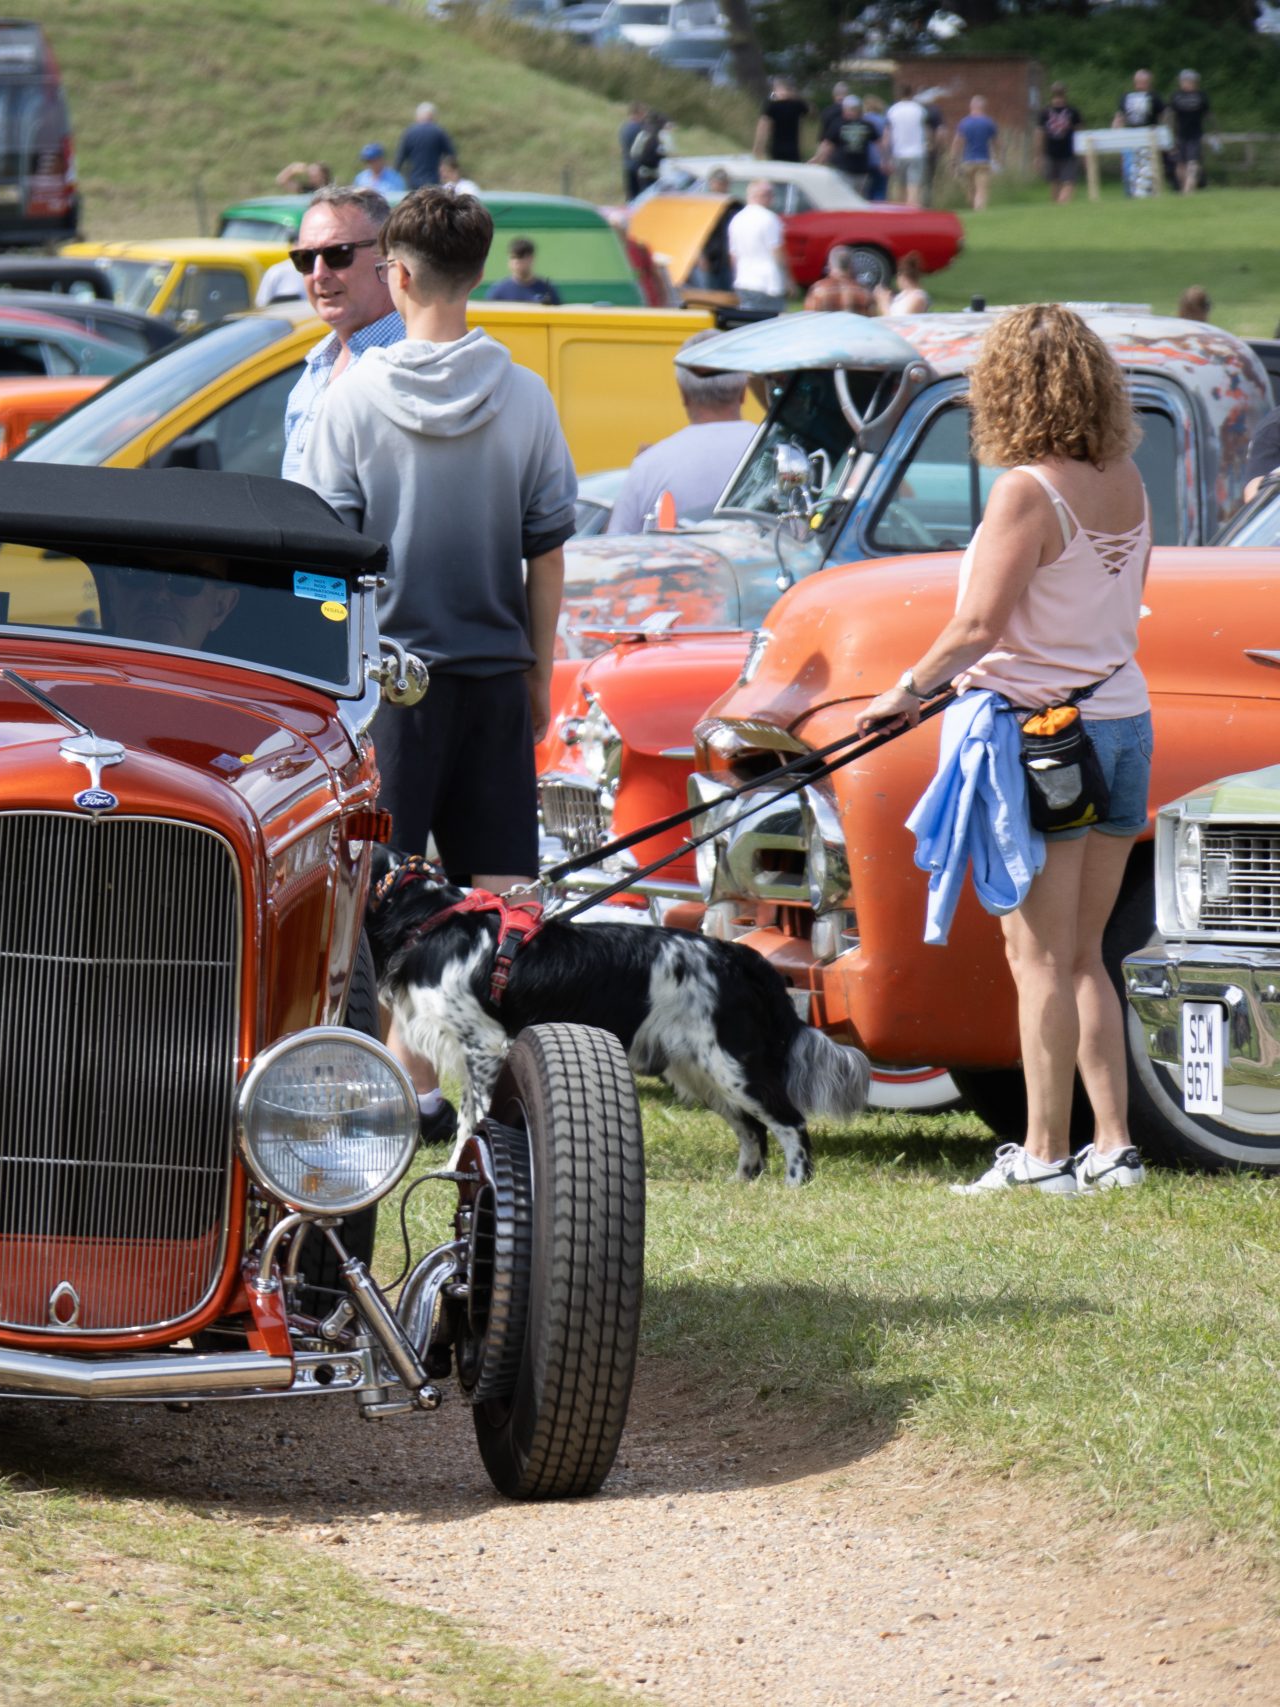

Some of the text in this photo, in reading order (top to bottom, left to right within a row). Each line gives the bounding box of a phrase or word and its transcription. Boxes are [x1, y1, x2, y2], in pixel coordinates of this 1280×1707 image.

[81, 792, 112, 806] Ford
[1190, 1014, 1214, 1055] SCW
[1187, 1061, 1219, 1102] 967L
